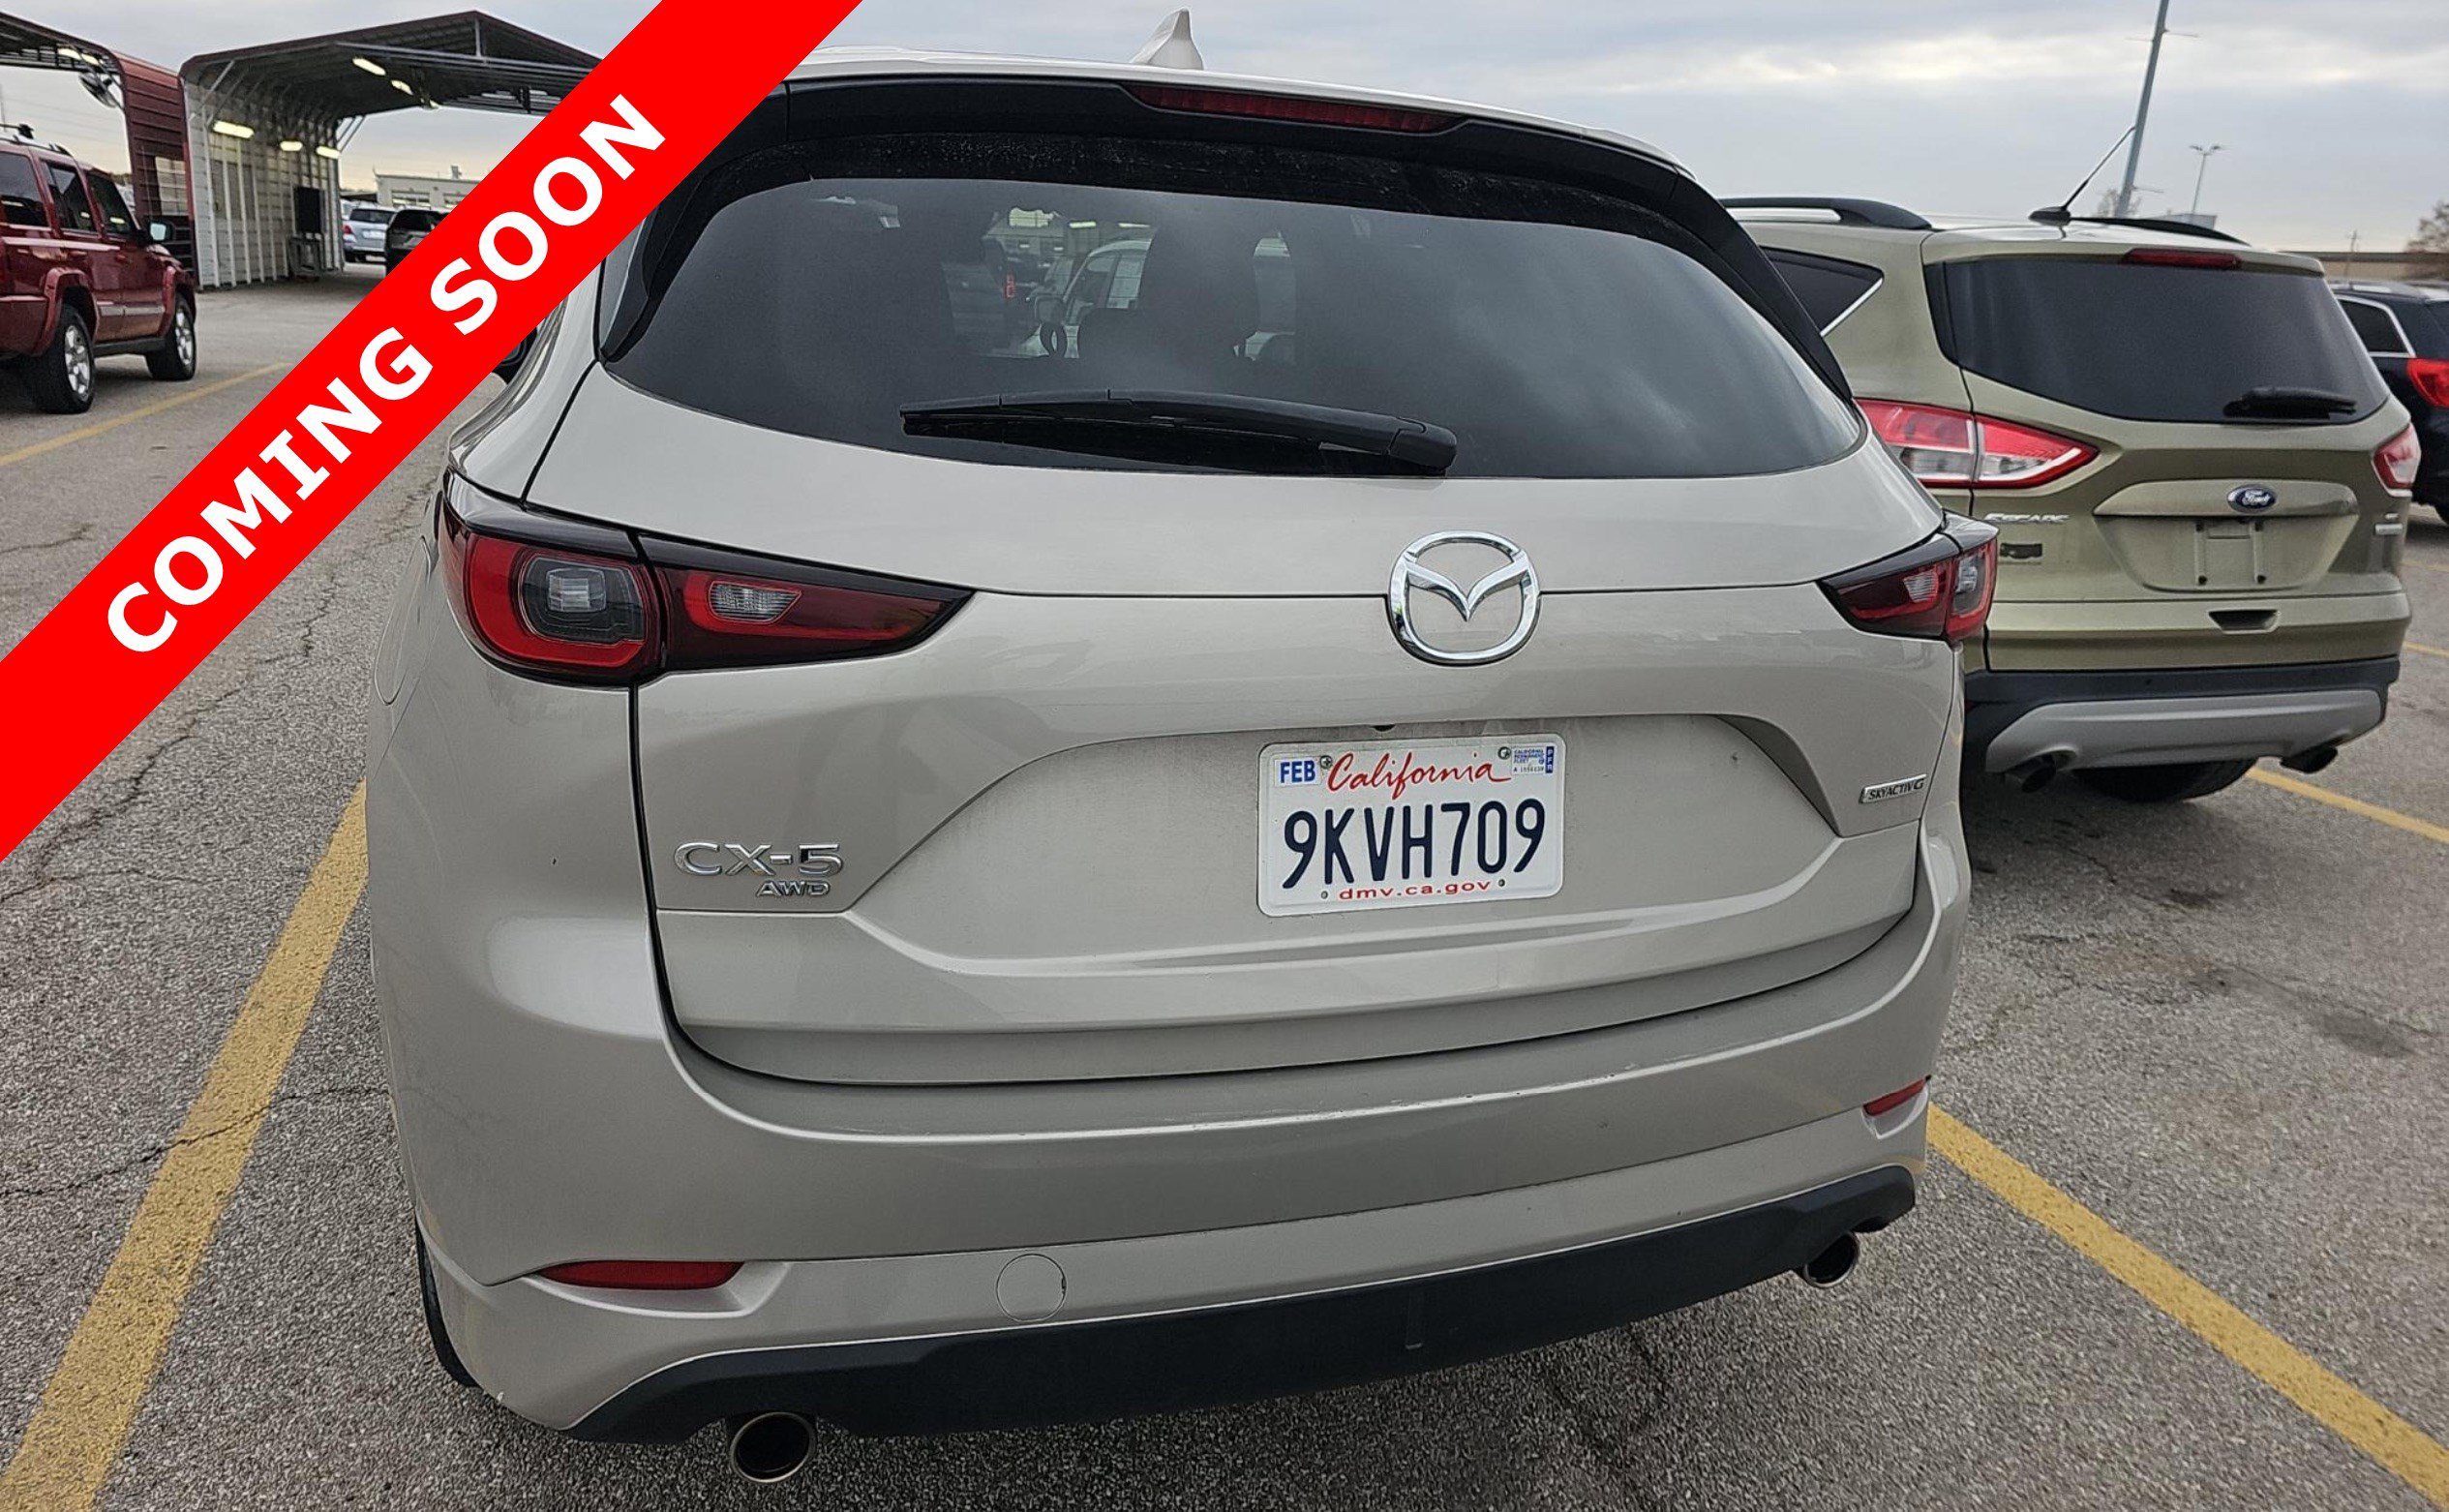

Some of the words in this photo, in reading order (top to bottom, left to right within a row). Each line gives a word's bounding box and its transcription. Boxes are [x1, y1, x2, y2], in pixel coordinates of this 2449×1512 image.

[1280, 760, 1316, 783] FEB
[1327, 751, 1511, 801] California
[675, 841, 843, 876] CX-5
[1282, 799, 1546, 889] 9KVH709
[755, 880, 831, 897] AWD
[1339, 879, 1491, 900] dmv.ca.gov
